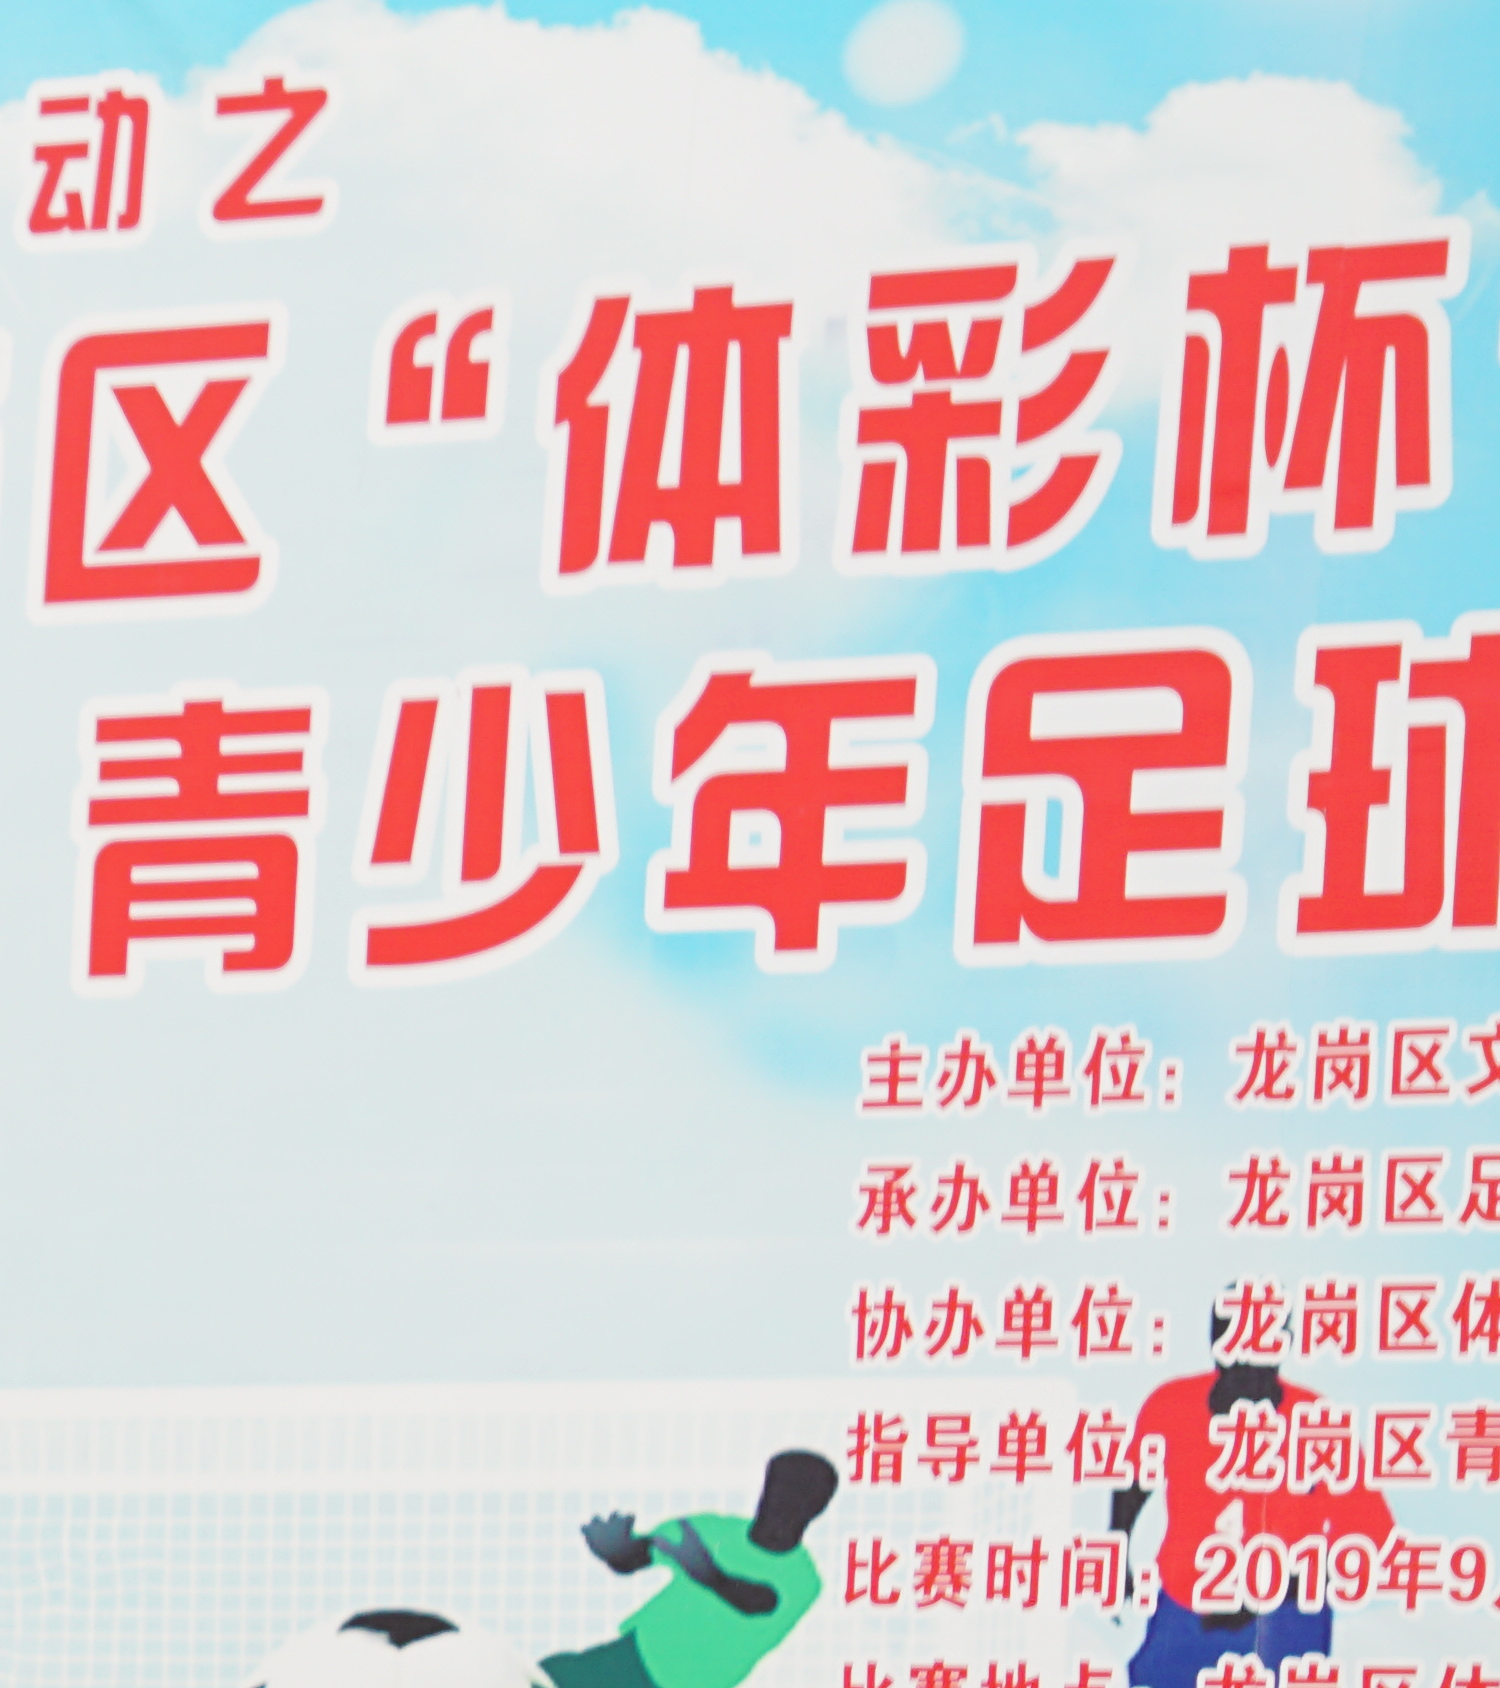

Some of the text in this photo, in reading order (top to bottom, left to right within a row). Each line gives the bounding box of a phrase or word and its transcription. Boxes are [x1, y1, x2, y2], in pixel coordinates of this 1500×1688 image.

[87, 632, 1500, 977] 青少年足球
[843, 1535, 1500, 1611] 比赛时间：2019年9
